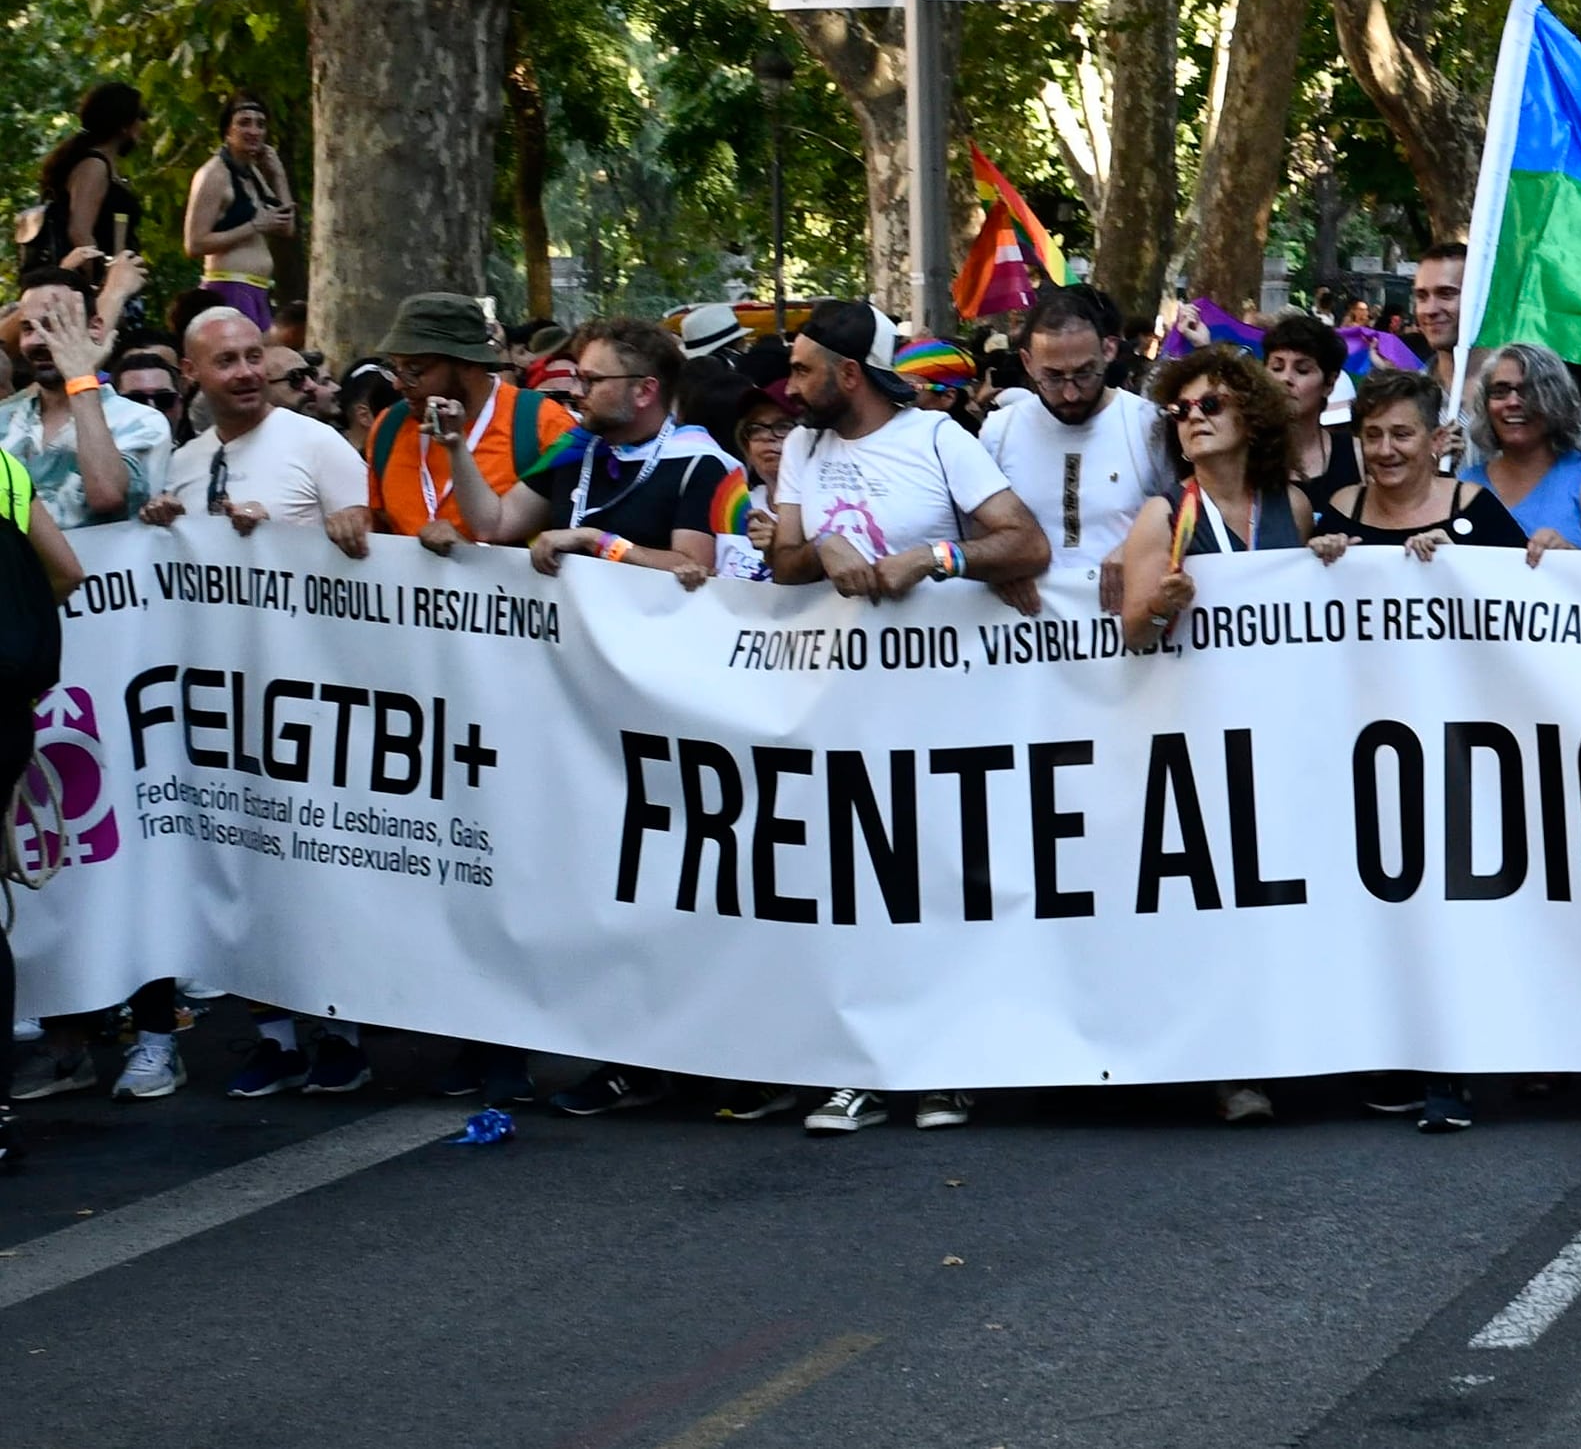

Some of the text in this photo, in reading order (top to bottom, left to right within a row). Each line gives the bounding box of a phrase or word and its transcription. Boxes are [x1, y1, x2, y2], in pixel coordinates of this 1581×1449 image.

[152, 561, 298, 618] VISIBILITAT,
[306, 574, 390, 624] ORGULL
[397, 586, 405, 624] I
[413, 585, 560, 644] RESILIÈNCIA
[728, 628, 824, 671] FRONTE
[828, 628, 868, 671] AO
[879, 625, 971, 674] ODIO,
[1192, 599, 1346, 650] ORGULLO
[1357, 598, 1374, 641] E
[124, 665, 498, 801] FELGTBI+
[136, 774, 495, 856] Federación Estatal de Lesbianas, Gais,
[199, 812, 285, 862] Bisexuales,
[291, 831, 431, 878] Intersexuales
[438, 858, 450, 886] y
[454, 854, 494, 889] más
[615, 729, 1096, 925] FRENTE
[1133, 727, 1307, 914] AL
